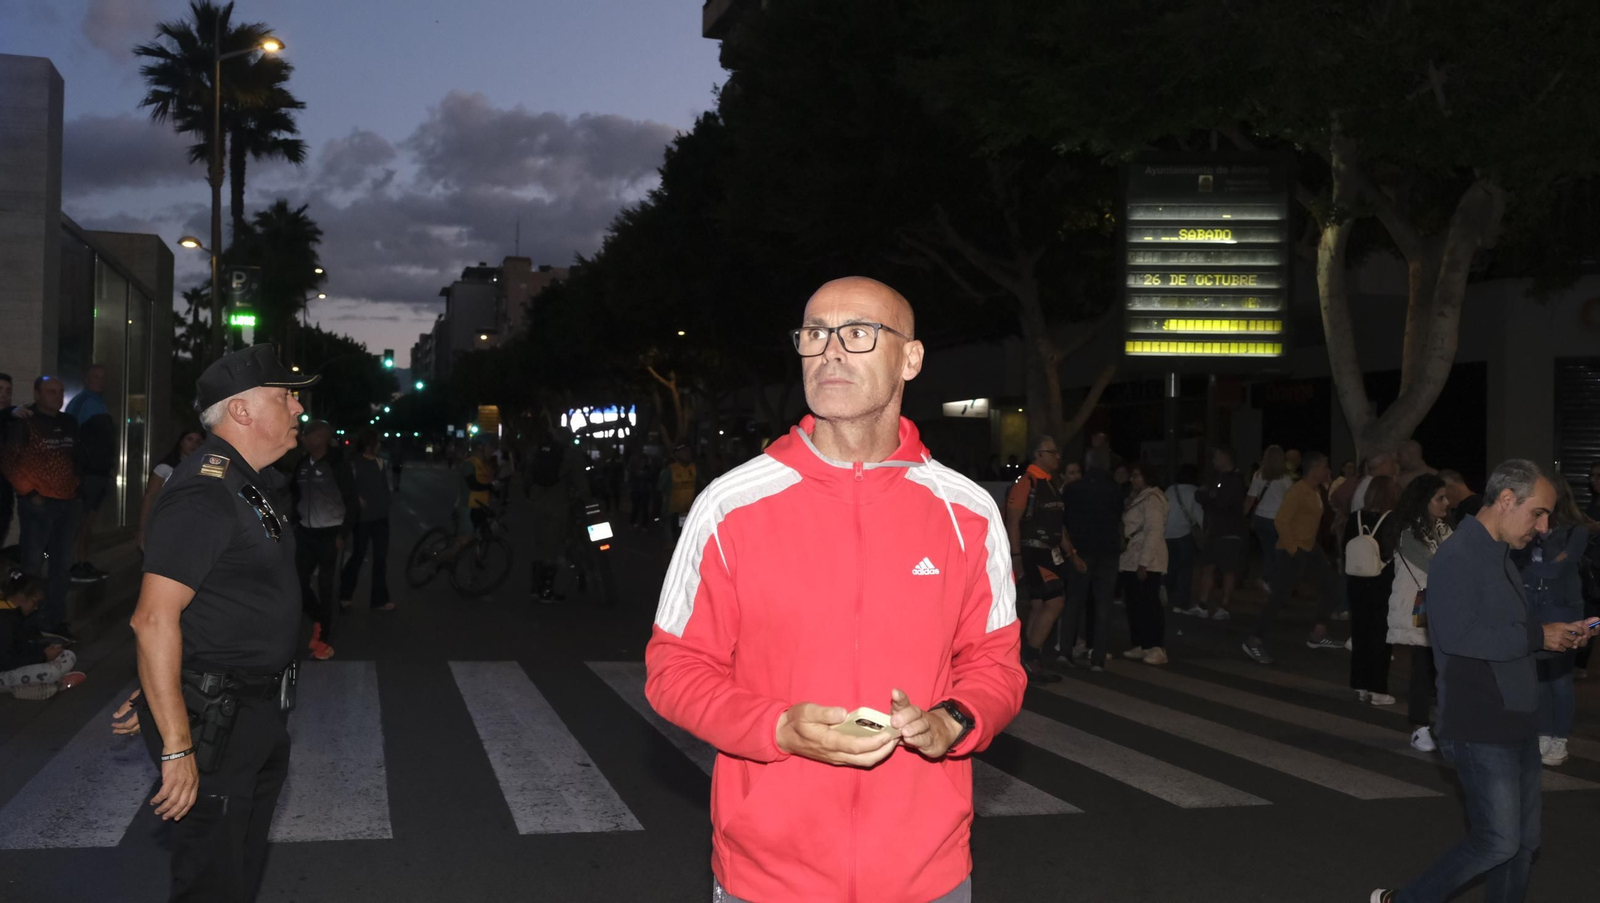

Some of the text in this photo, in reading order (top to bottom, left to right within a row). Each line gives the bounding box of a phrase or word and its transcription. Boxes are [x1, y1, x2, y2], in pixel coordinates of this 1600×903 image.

[1144, 165, 1214, 176] Ayuntamiento
[1216, 165, 1229, 175] de
[1178, 229, 1232, 241] SABADO
[1143, 274, 1257, 286] 26 DE OCTUBRE
[912, 568, 940, 576] adidas
